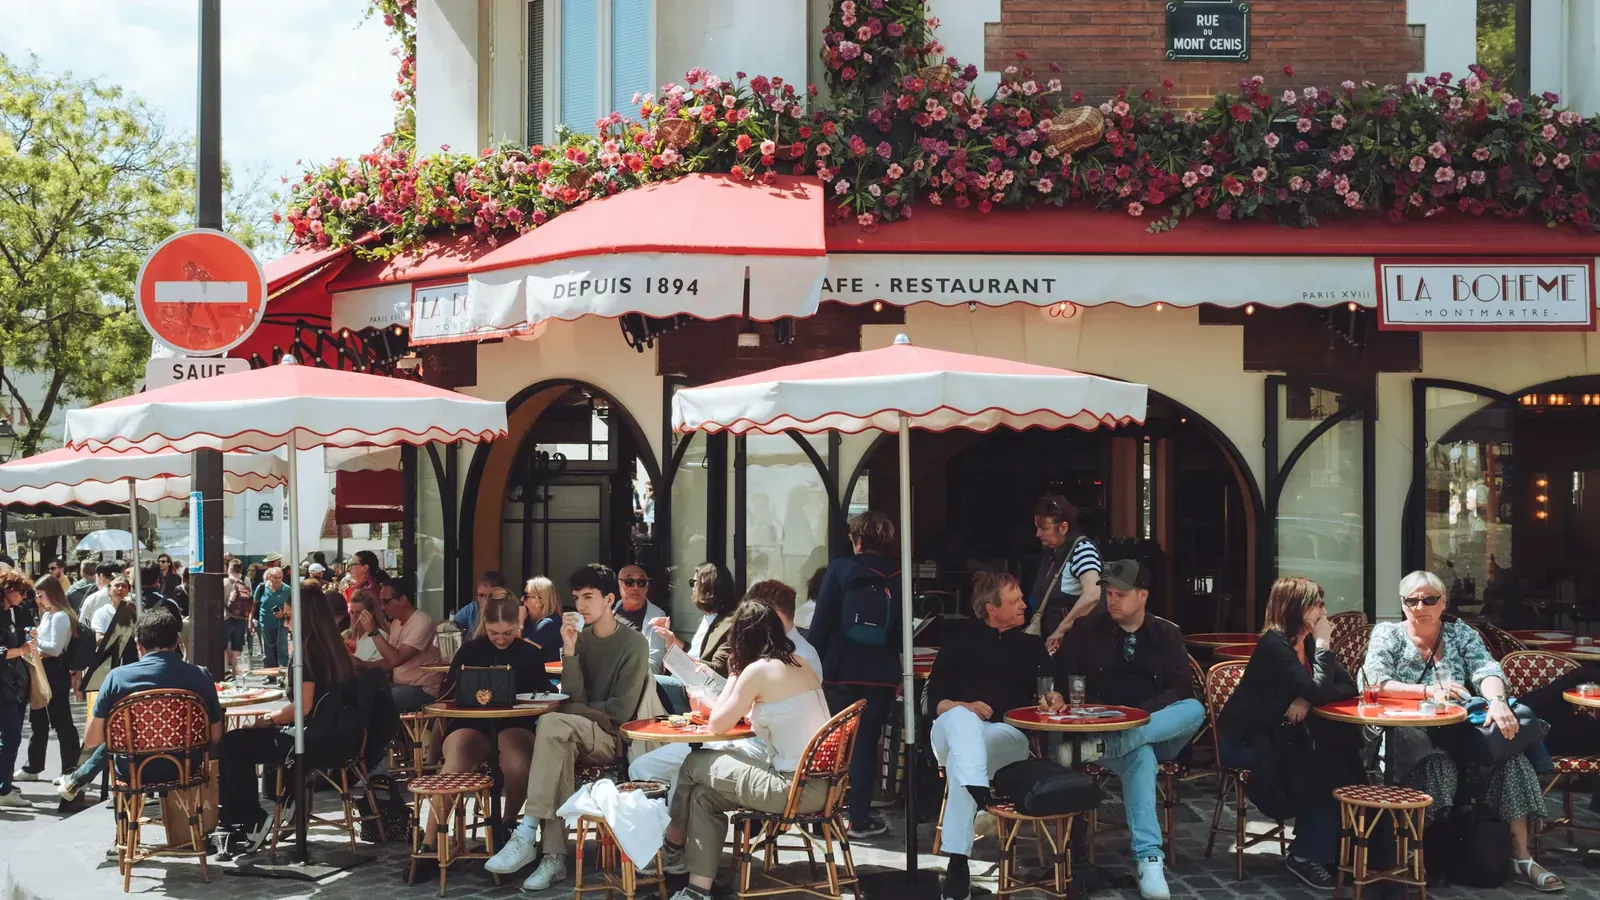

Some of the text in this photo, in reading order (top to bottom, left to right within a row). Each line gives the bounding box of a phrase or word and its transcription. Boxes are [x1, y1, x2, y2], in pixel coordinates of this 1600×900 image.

[1196, 14, 1220, 27] RUE
[1173, 38, 1242, 50] MONT CENIS
[553, 277, 699, 300] DEPUIS 1894
[890, 277, 1056, 294] RESTAURANT
[1396, 274, 1578, 303] LA BOHEME
[1302, 290, 1370, 300] PARIS XVIII
[420, 295, 441, 320] LA
[369, 315, 388, 323] PARIS
[172, 363, 226, 380] SAUF
